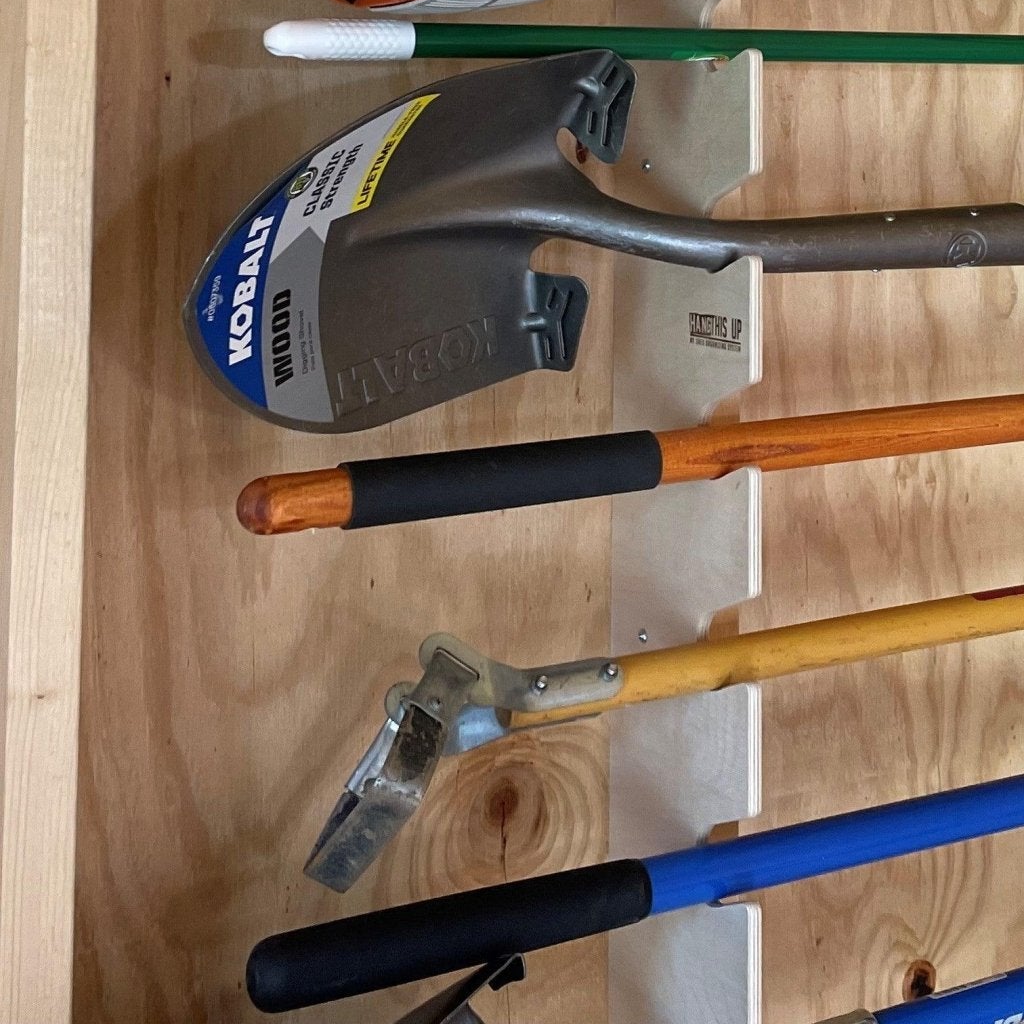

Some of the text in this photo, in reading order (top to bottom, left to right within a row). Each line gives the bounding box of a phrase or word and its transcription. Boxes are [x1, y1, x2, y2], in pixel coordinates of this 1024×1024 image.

[303, 149, 346, 217] CLASSIC
[320, 143, 364, 210] Strength
[357, 139, 397, 206] LIFETIME
[228, 215, 275, 366] KOBALT
[272, 289, 293, 387] WOOD
[731, 318, 742, 340] UP
[335, 314, 500, 417] KOBALT
